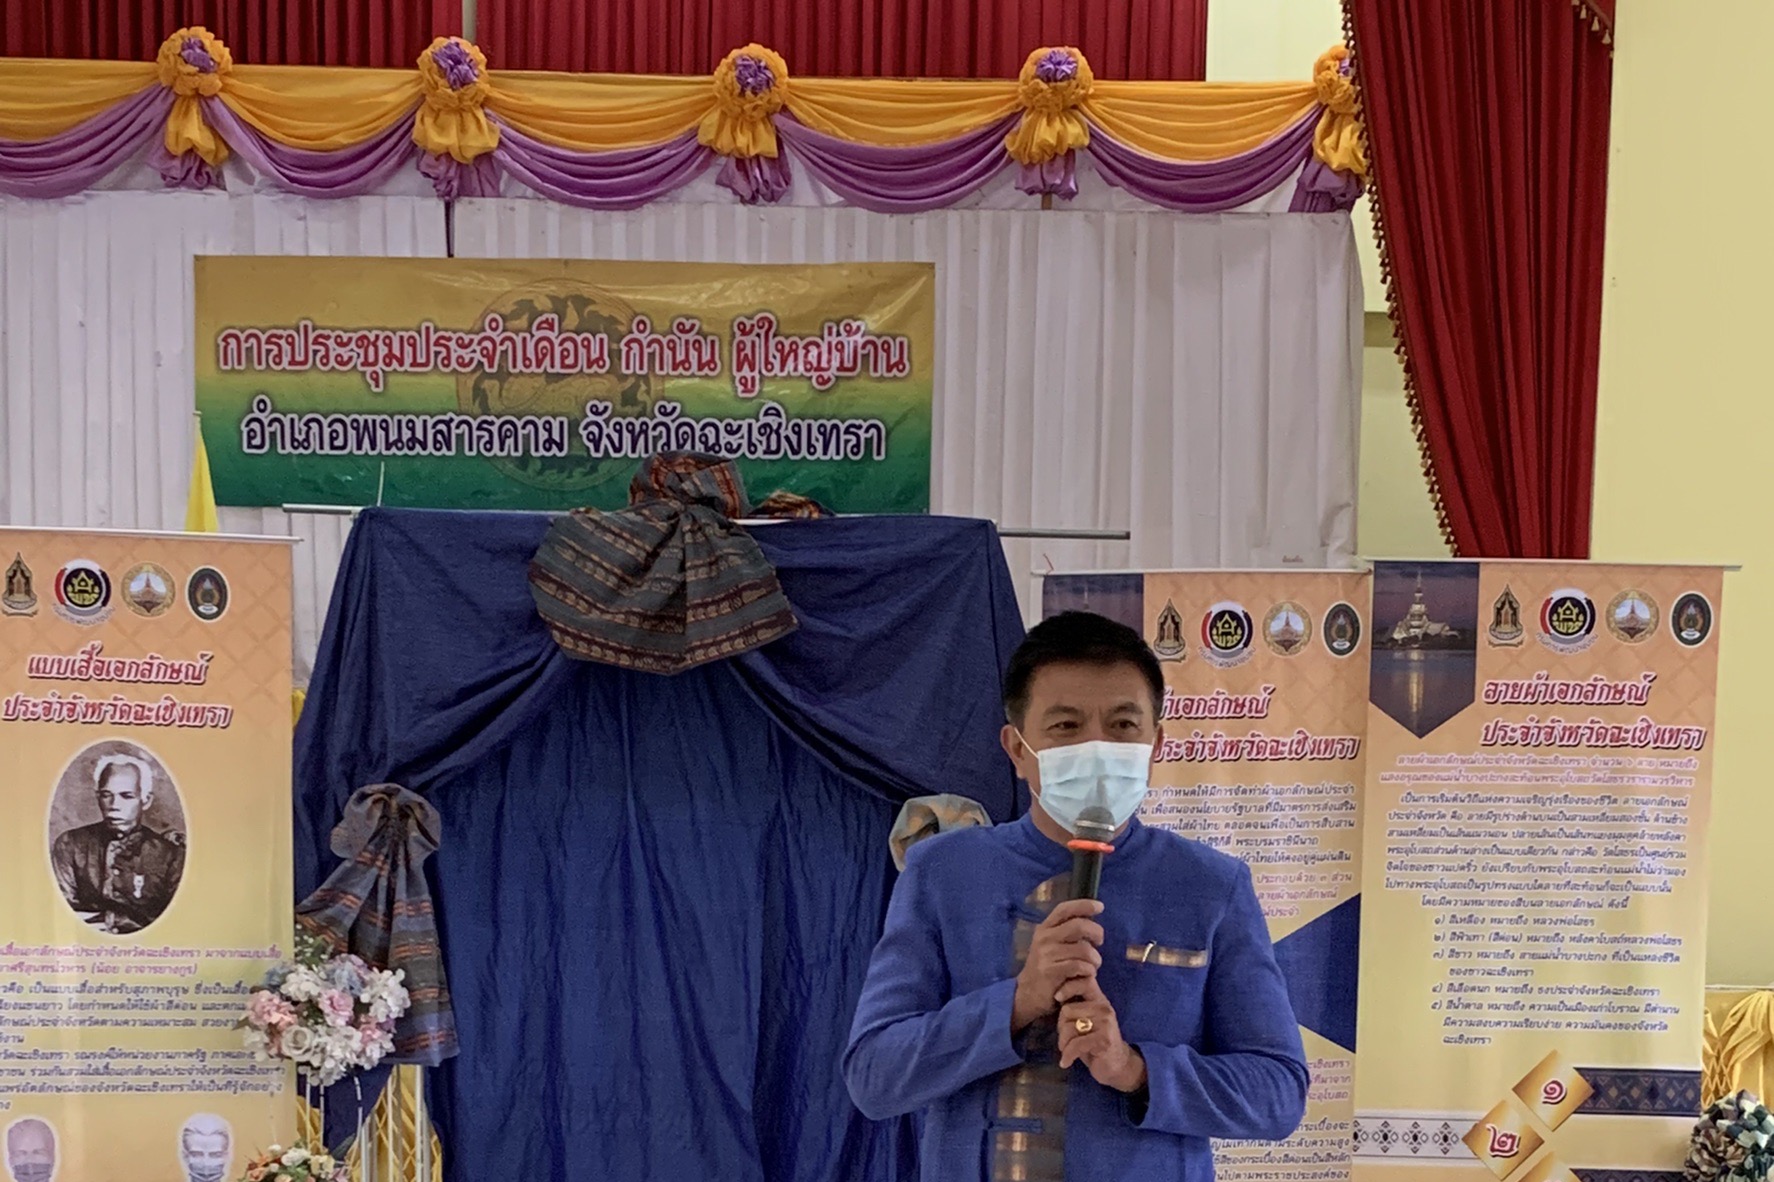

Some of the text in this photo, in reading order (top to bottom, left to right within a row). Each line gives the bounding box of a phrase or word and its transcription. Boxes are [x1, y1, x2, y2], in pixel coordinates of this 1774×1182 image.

[219, 317, 909, 395] การประชุมประจำเดือน กำนัน ผู้ใหญ่บ้าน
[242, 394, 886, 460] อำเภอพนมสารคาม จังหวัดฉะเชิงเทรา
[28, 641, 214, 684] แบบเสื้อเอกลักษณ์
[1483, 671, 1657, 705] ลายผ้าเอกลักษณ์
[2, 691, 232, 727] ประจำจังหวัดฉะเชิงเทรา
[1480, 714, 1707, 751] ประจำจังหวัดฉะเชิงเทรา
[1542, 1079, 1567, 1105] ๑
[1485, 1123, 1521, 1158] ๒
